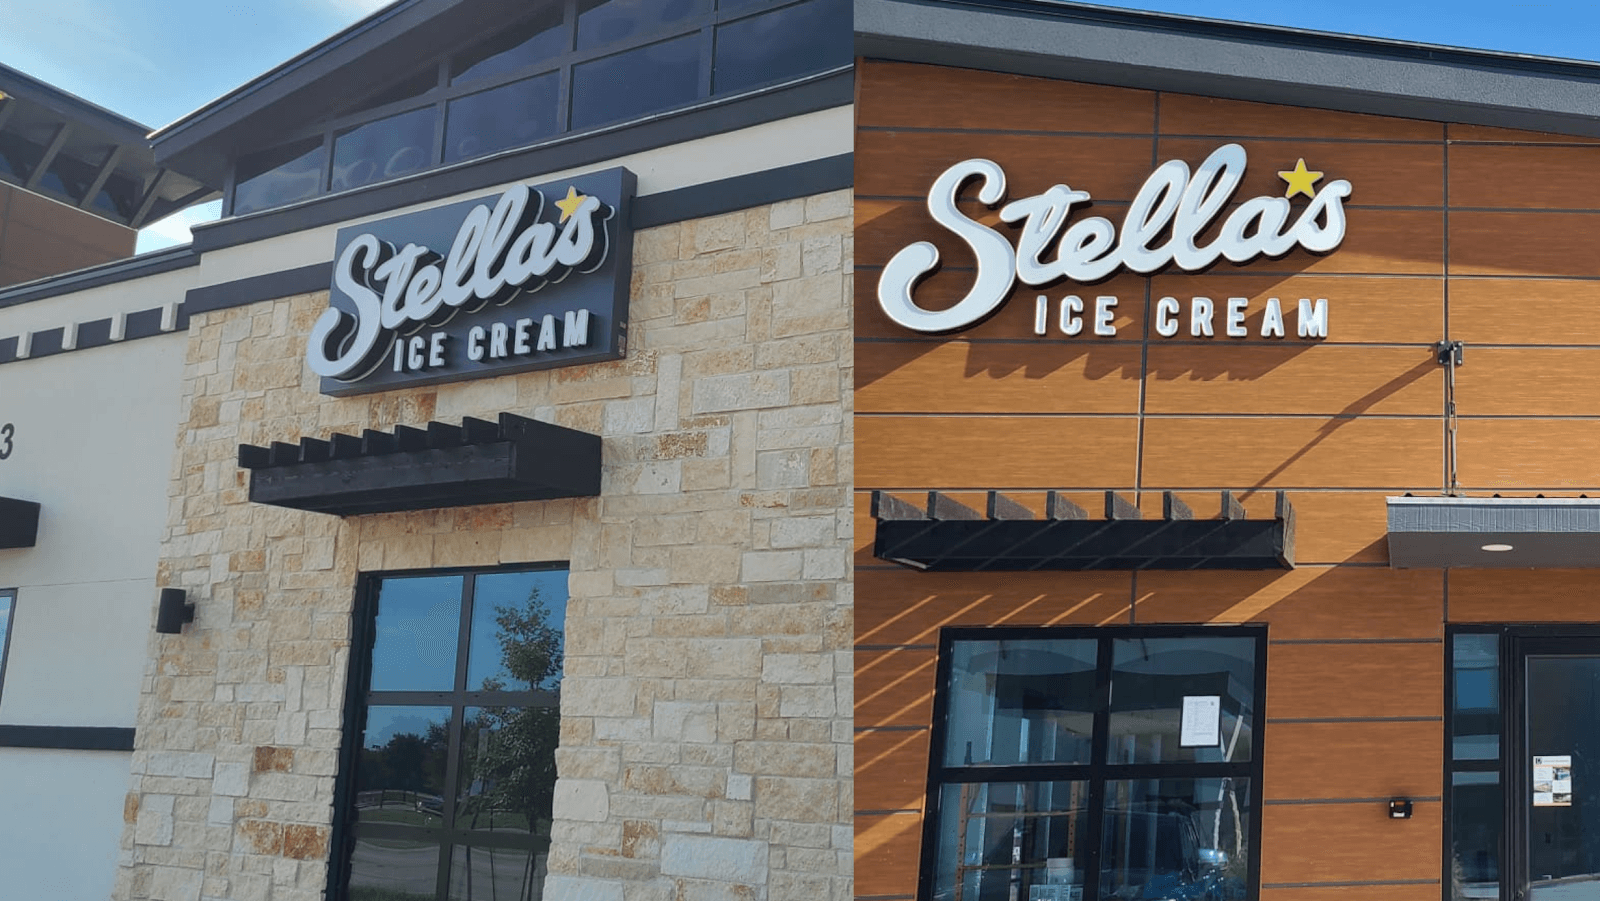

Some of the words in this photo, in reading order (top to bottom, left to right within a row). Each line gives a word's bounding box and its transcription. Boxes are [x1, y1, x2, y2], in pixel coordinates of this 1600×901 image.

[1034, 294, 1118, 336] ICE
[1155, 296, 1329, 337] CREAM
[394, 332, 446, 372] ICE
[467, 309, 589, 361] CREAM
[0, 423, 15, 460] 3
